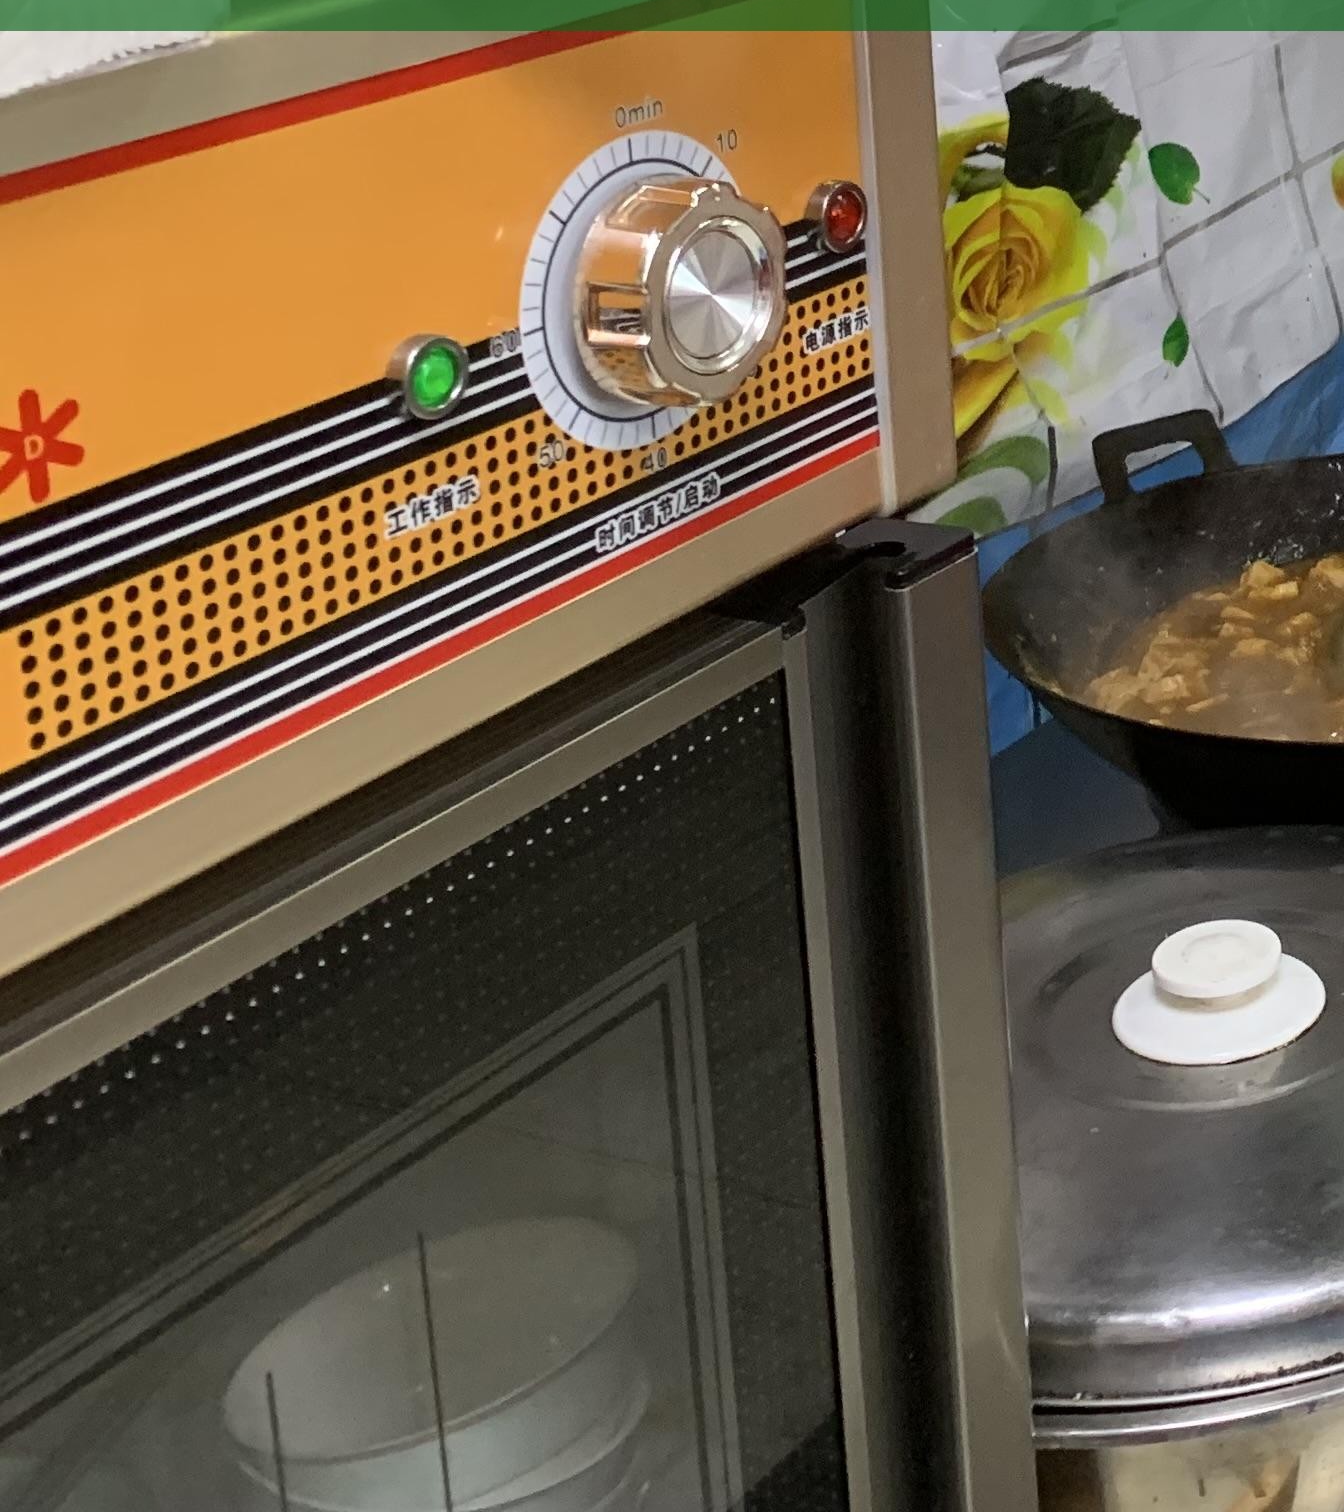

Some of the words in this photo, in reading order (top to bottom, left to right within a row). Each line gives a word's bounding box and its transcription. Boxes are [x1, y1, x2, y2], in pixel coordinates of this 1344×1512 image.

[615, 99, 664, 129] 0min
[716, 127, 738, 153] 10
[490, 329, 520, 358] 60
[805, 307, 869, 352] 电源指示
[540, 439, 565, 469] 50
[641, 446, 668, 472] 40
[387, 475, 480, 537] 工作指示
[597, 476, 720, 551] 时间调节/启动
